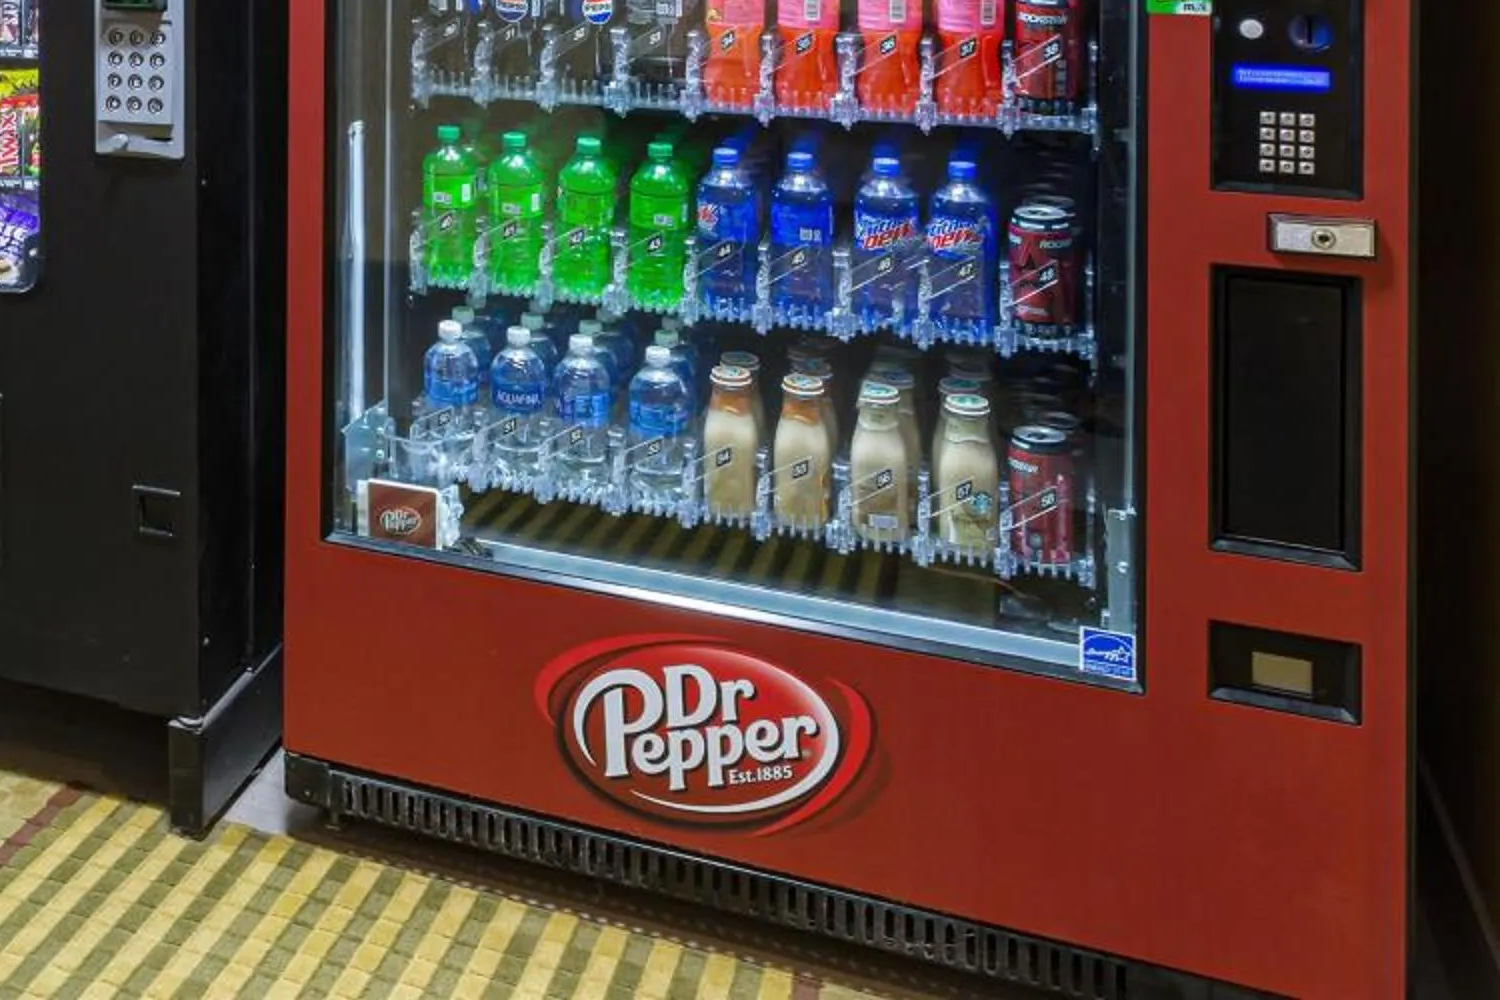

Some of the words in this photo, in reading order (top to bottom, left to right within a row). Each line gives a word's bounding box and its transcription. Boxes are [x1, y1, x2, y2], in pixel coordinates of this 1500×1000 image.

[664, 664, 755, 727] Dr
[573, 669, 818, 790] Pepper
[729, 766, 793, 785] Est.1885
